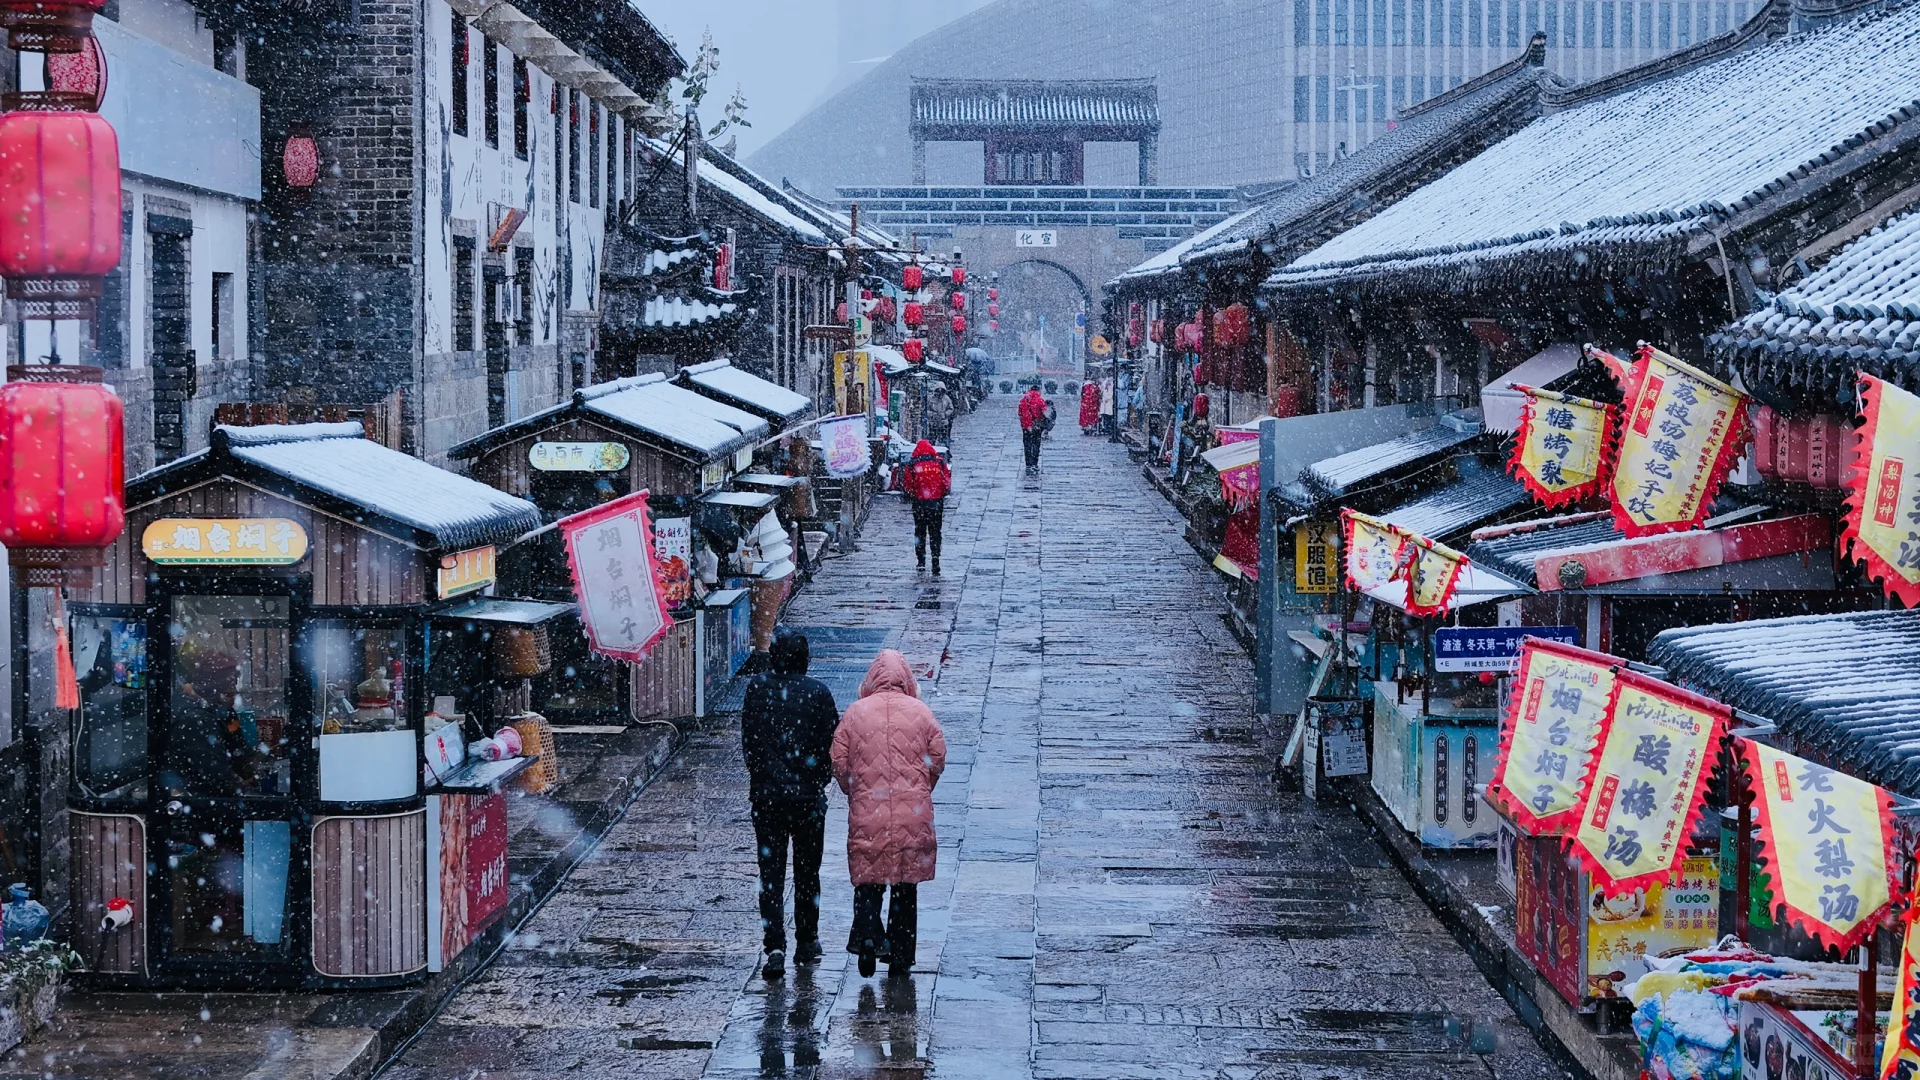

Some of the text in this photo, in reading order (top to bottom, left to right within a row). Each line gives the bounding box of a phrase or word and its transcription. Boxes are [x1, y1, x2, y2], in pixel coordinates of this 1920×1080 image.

[1879, 463, 1900, 522] 梨汤神
[172, 522, 297, 554] 烟台焖子
[1307, 524, 1327, 586] 汉服馆
[597, 526, 637, 642] 烟台焖子
[1532, 683, 1583, 813] 烟台焖子
[1777, 764, 1790, 796] 梨汤神
[1604, 734, 1672, 868] 酸梅汤
[1796, 763, 1860, 923] 老火梨汤
